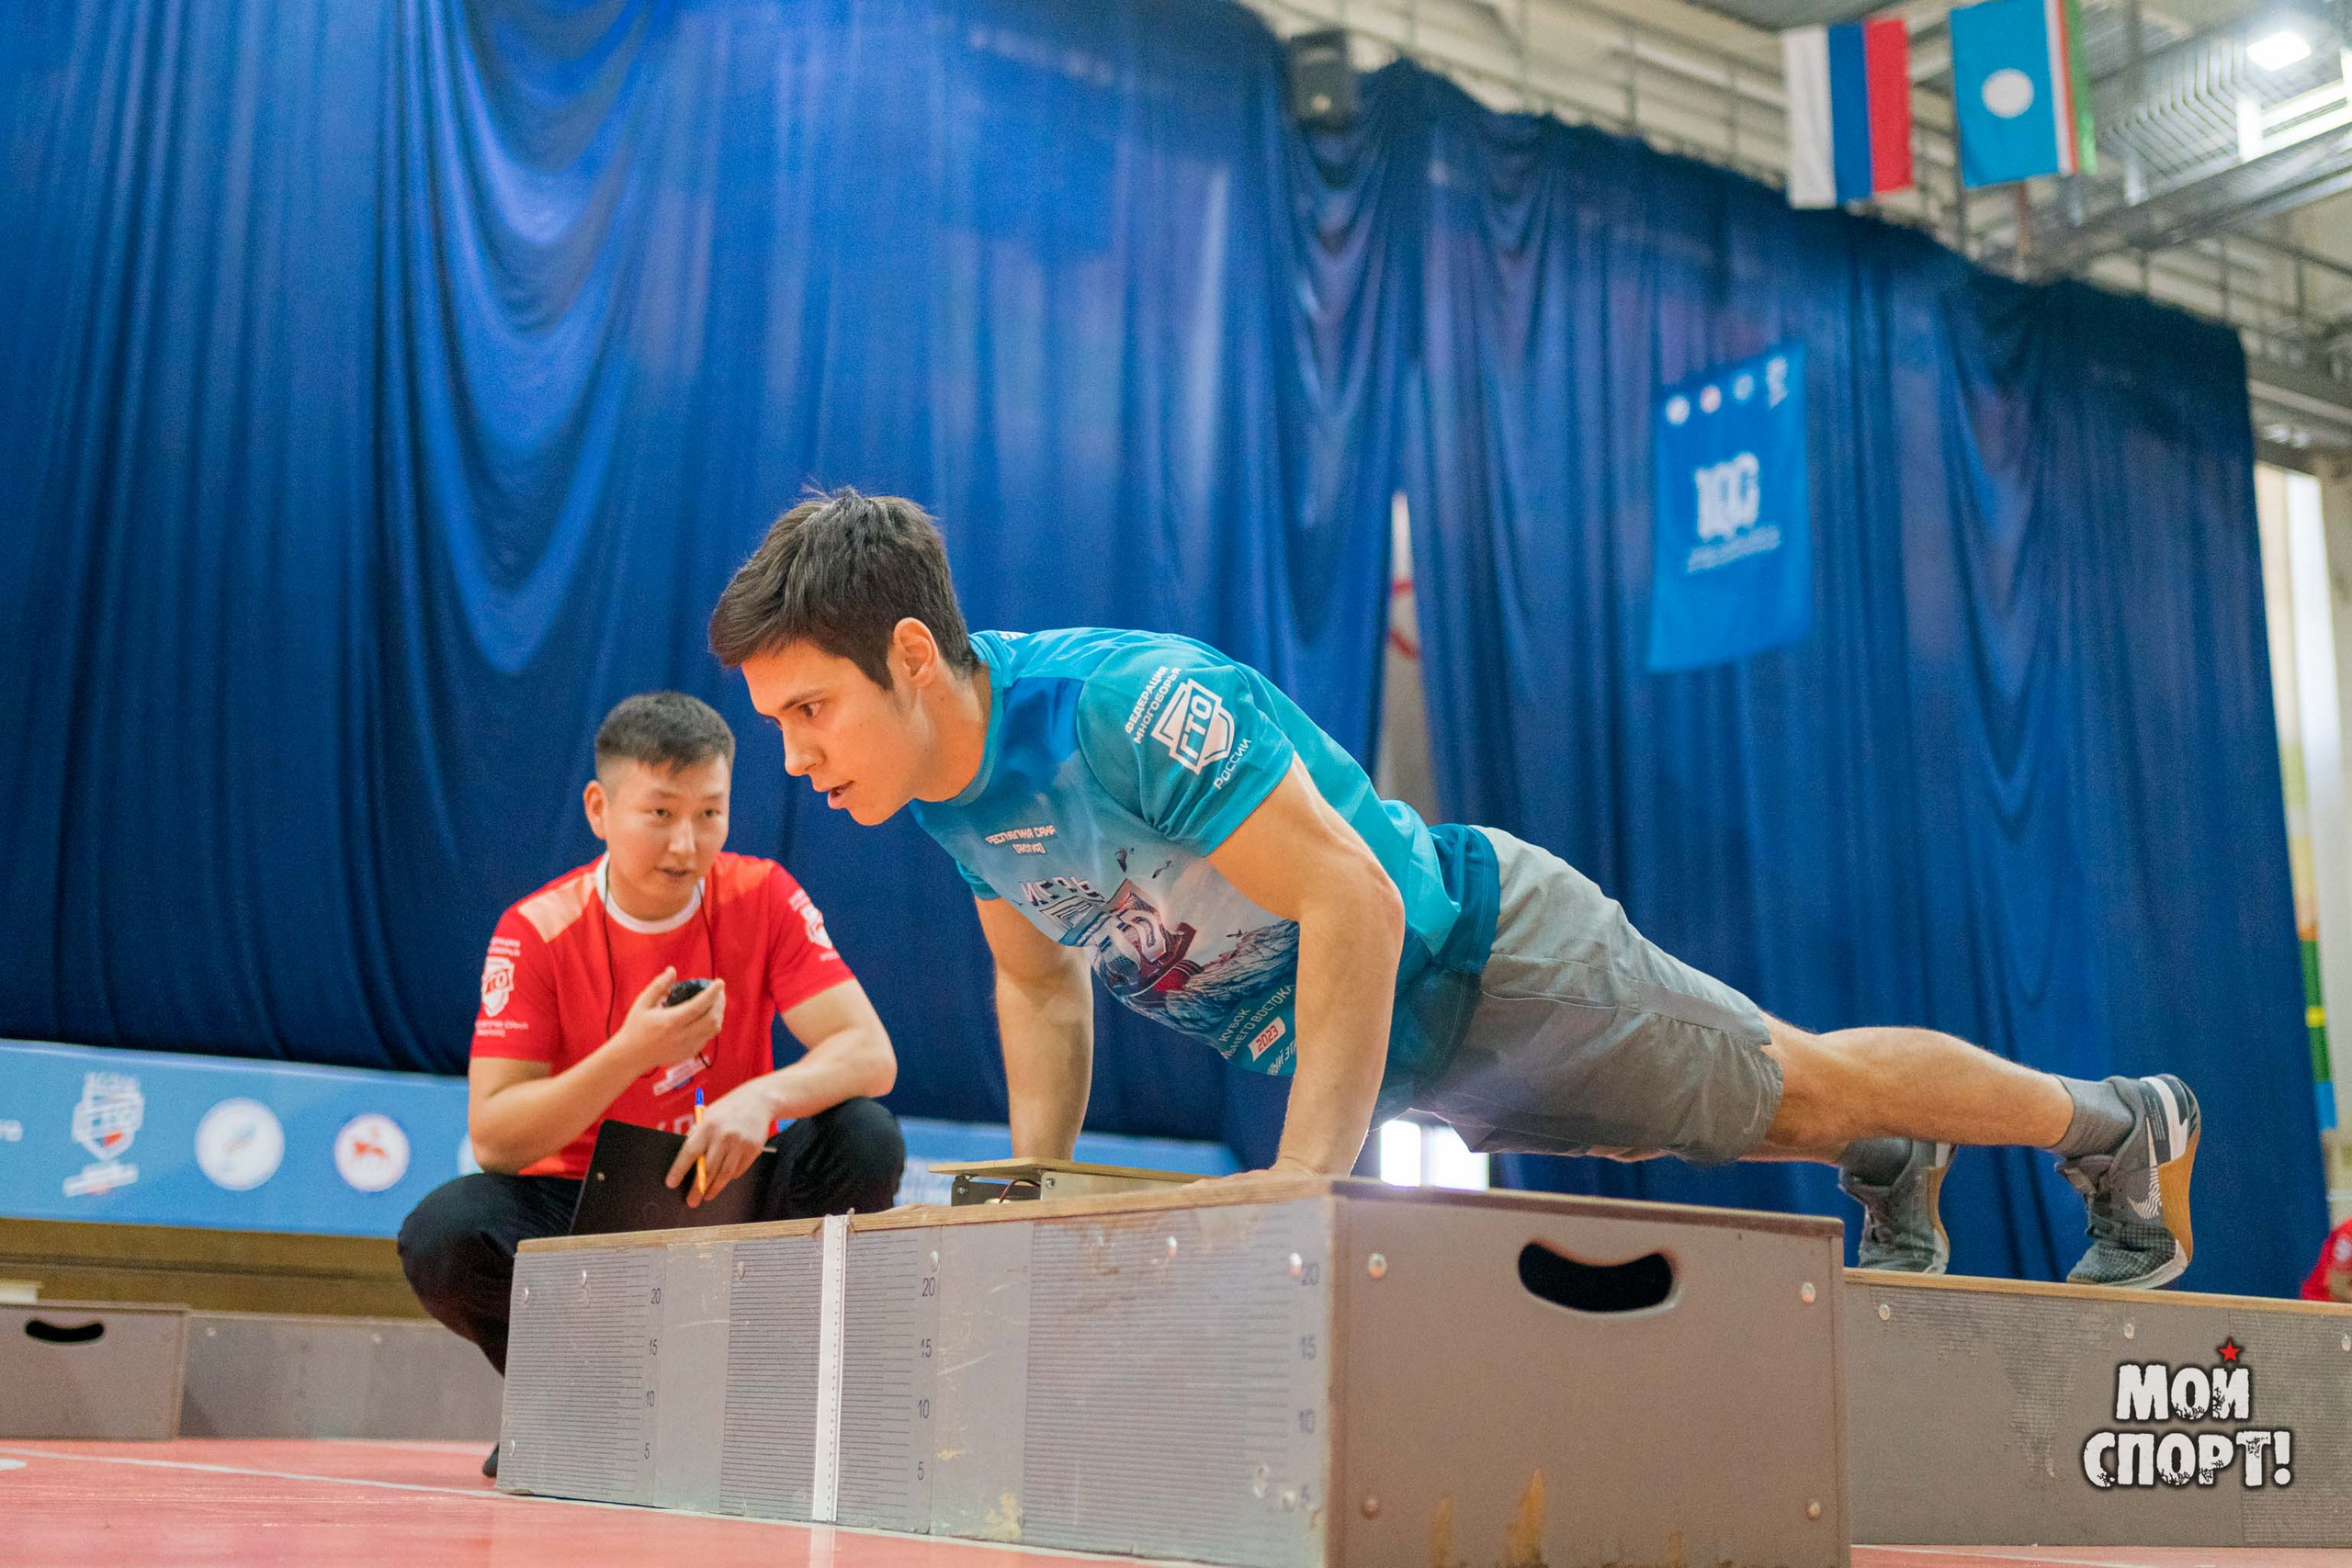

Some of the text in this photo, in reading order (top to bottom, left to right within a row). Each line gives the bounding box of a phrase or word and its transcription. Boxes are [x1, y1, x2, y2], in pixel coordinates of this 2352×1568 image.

[1124, 666, 1169, 734] ФЕДЕРАЦИЯ
[1133, 667, 1182, 744] МНОГОБОРЬЯ
[1179, 694, 1213, 759] ГТО
[1213, 739, 1252, 790] РОССИИ
[1219, 1009, 1250, 1042] КУБОК
[1255, 1025, 1279, 1053] 2023
[650, 1288, 661, 1304] 20
[922, 1277, 935, 1297] 20
[649, 1339, 658, 1356] 15
[921, 1338, 932, 1358] 15
[646, 1391, 655, 1407] 10
[918, 1399, 930, 1418] 10
[644, 1443, 650, 1460] 5
[917, 1461, 924, 1481] 5
